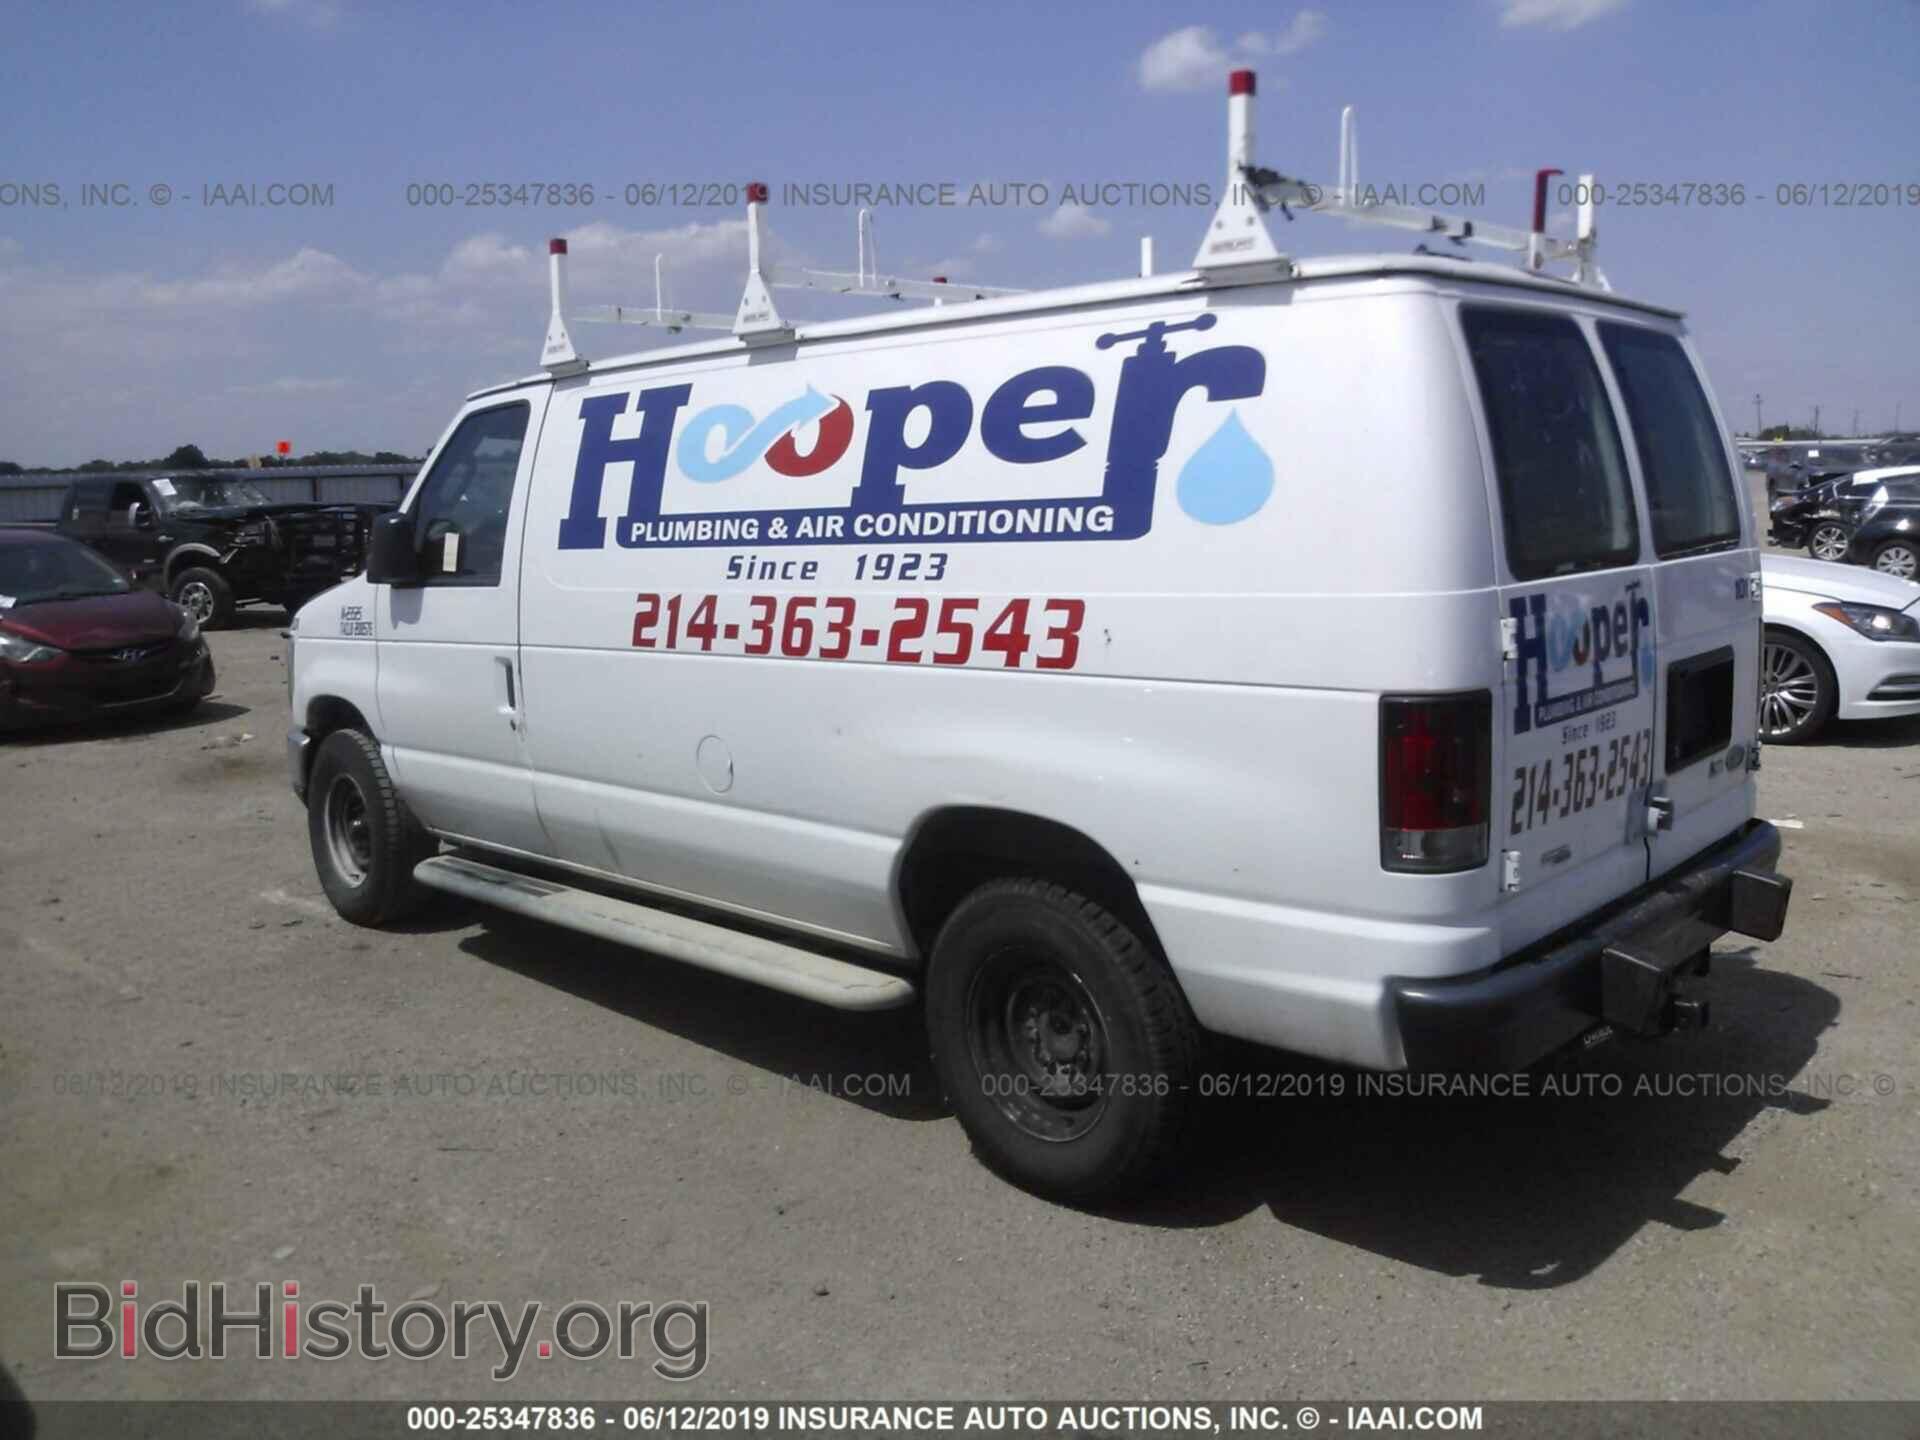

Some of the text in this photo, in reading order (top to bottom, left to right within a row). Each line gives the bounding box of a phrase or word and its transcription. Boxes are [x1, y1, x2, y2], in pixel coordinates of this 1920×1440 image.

[558, 314, 1266, 549] Hooper
[631, 504, 1115, 543] PLUMBING & AIR CONDITIONING
[726, 553, 950, 581] Since 1923
[631, 594, 1086, 671] 214-363-2543
[1509, 582, 1650, 735] Hooper
[1510, 728, 1651, 835] 214-363-2543
